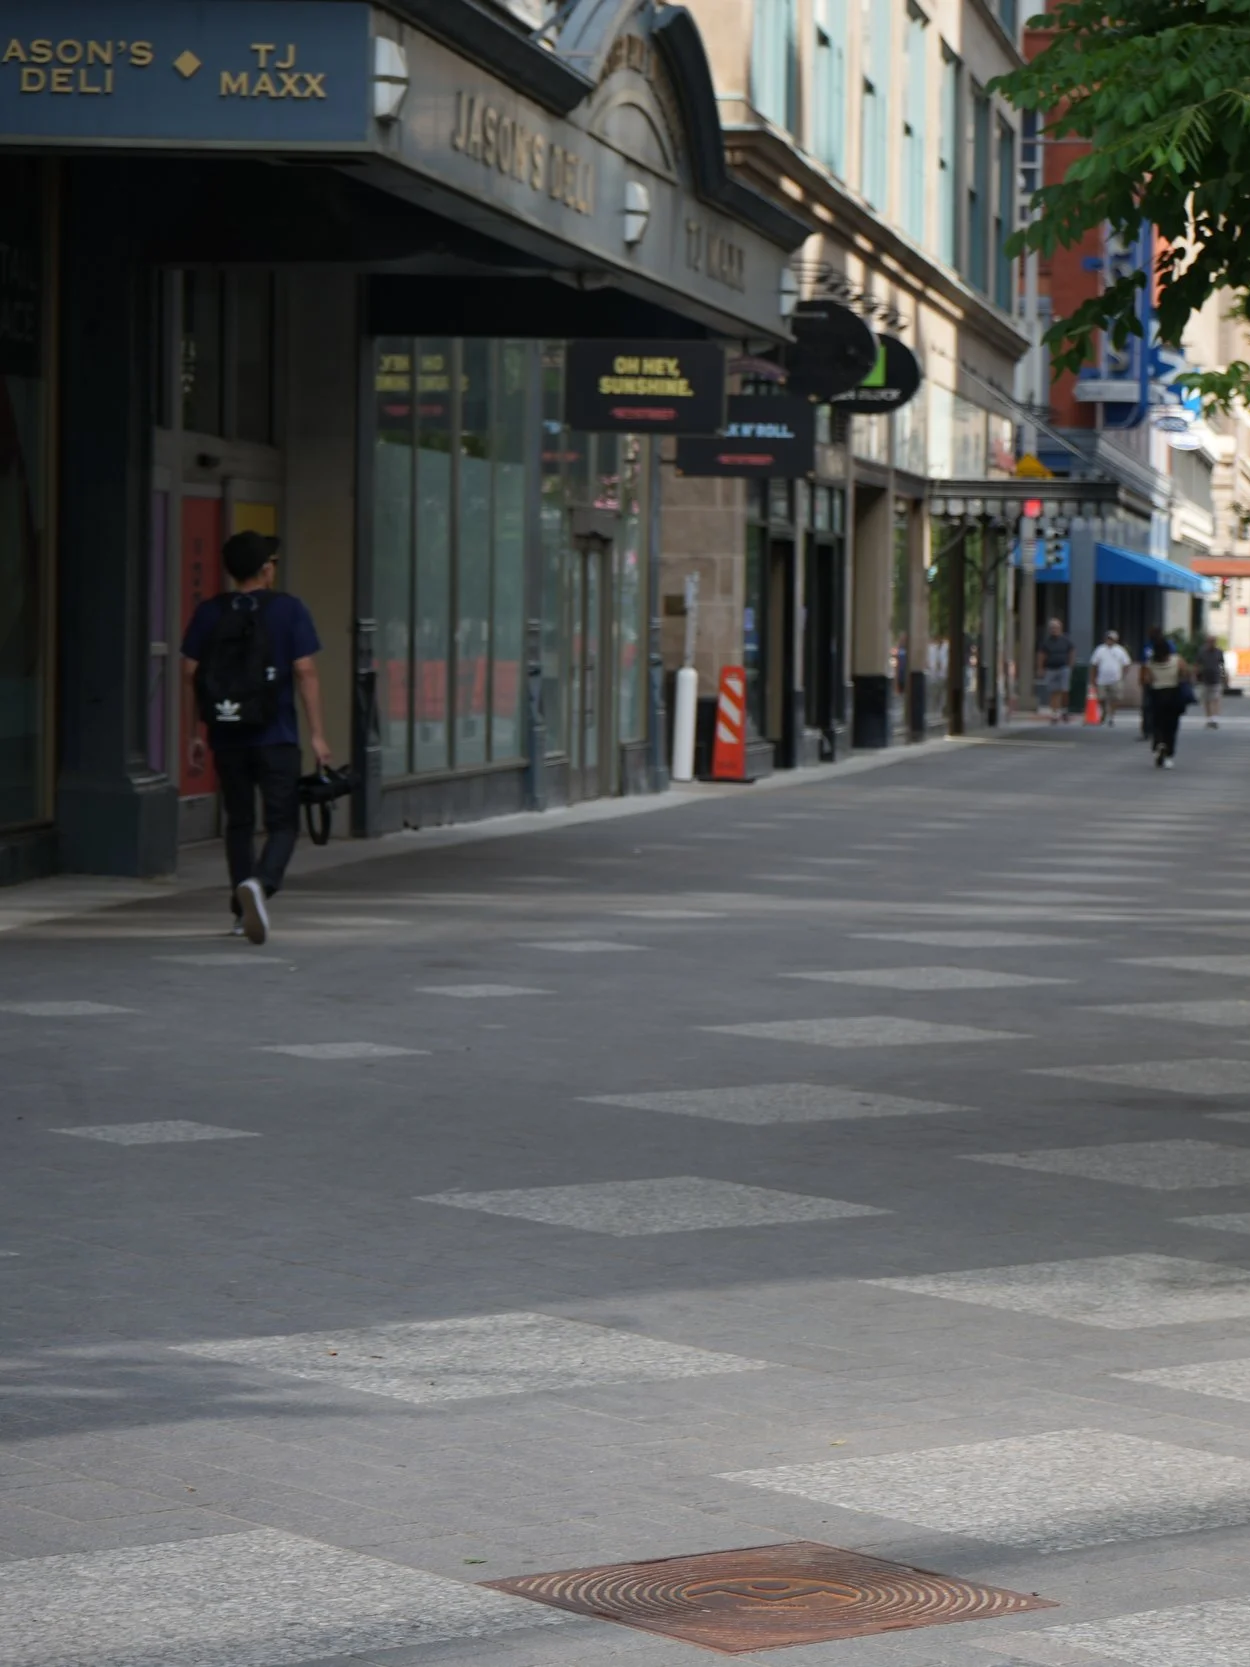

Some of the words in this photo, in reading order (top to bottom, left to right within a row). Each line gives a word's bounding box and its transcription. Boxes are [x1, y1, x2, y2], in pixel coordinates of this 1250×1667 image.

[251, 43, 296, 70] TJ
[20, 68, 114, 93] DELI
[220, 71, 327, 98] MAXX
[614, 356, 640, 374] OH
